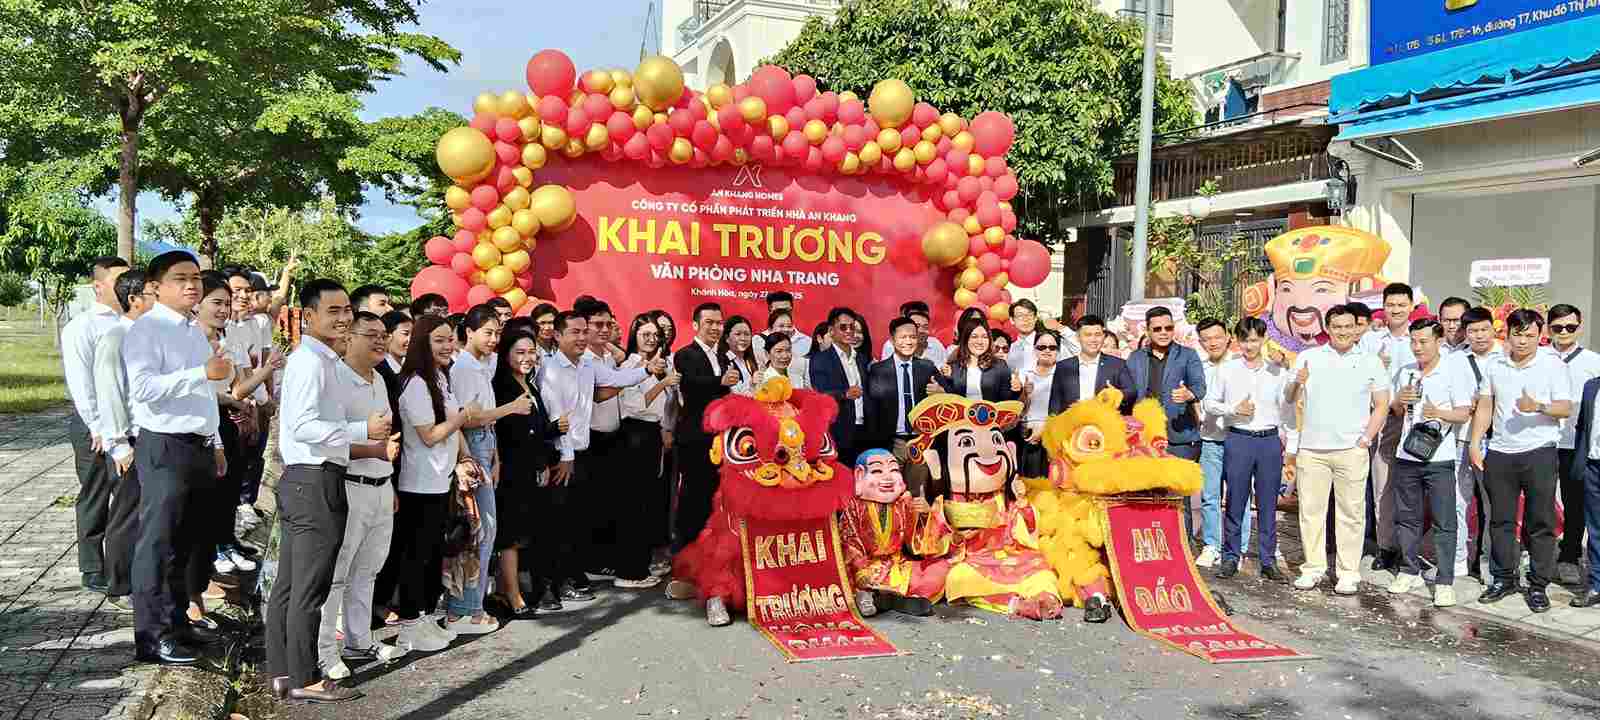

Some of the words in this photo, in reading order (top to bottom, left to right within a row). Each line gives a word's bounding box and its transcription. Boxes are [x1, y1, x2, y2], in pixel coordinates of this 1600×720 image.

[1532, 8, 1552, 22] Khu
[711, 188, 724, 198] AN
[725, 189, 754, 199] KHANG
[755, 191, 784, 200] HOMES
[631, 198, 664, 212] CÔNG
[666, 202, 679, 212] TY
[823, 211, 857, 223] KHANG
[597, 215, 701, 257] KHAI
[712, 222, 887, 266] TRƯƠNG
[650, 261, 684, 279] VĂN
[687, 263, 748, 282] PHÒNG
[751, 268, 784, 284] NHA
[786, 270, 840, 286] TRANG
[690, 287, 717, 297] Khánh
[738, 289, 759, 300] ngày
[754, 529, 828, 570] KHAI
